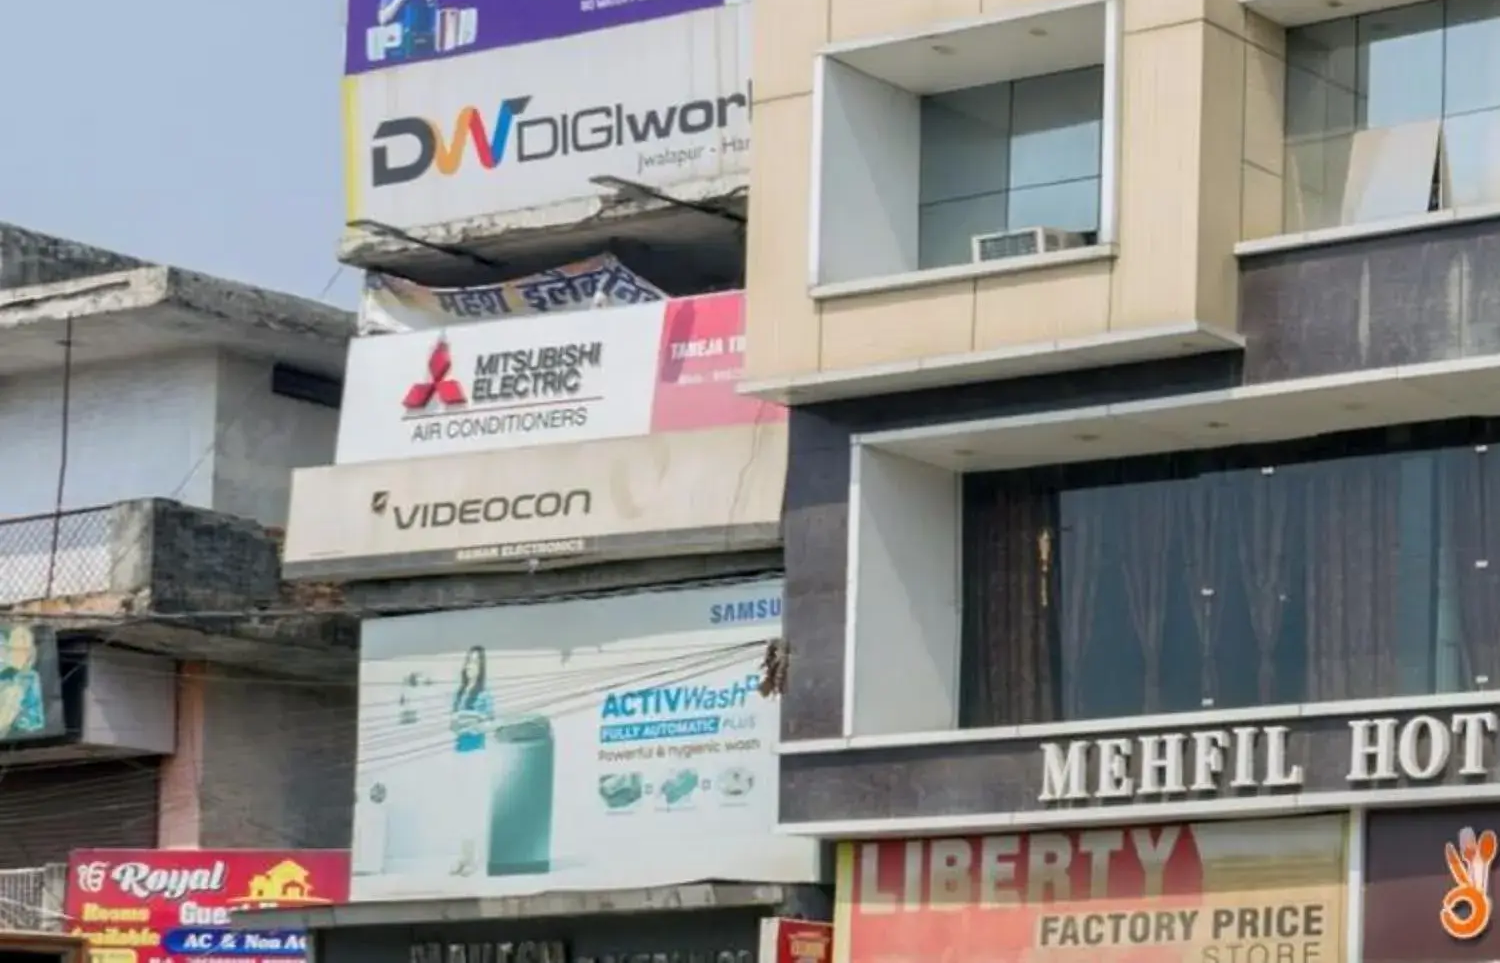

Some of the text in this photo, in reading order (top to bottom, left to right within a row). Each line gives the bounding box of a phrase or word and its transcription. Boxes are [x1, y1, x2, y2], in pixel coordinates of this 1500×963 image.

[474, 341, 603, 377] MITSUBISHI
[471, 367, 582, 402] ELECTRIC
[411, 407, 588, 443] AIR CONDITIONERS
[602, 724, 641, 741] FULLY
[643, 718, 719, 738] AUTOMATIC
[598, 745, 654, 762] Powerful
[724, 737, 760, 752] wash
[1038, 725, 1303, 803] MEHFIL
[111, 859, 227, 898] Royal
[859, 825, 1183, 915] LIBERTY
[82, 902, 150, 923] Rooms
[1039, 904, 1323, 947] FACTORY PRICE
[183, 933, 212, 950] AC
[221, 932, 237, 949] &
[245, 933, 282, 950] Non
[1201, 941, 1321, 963] STORE
